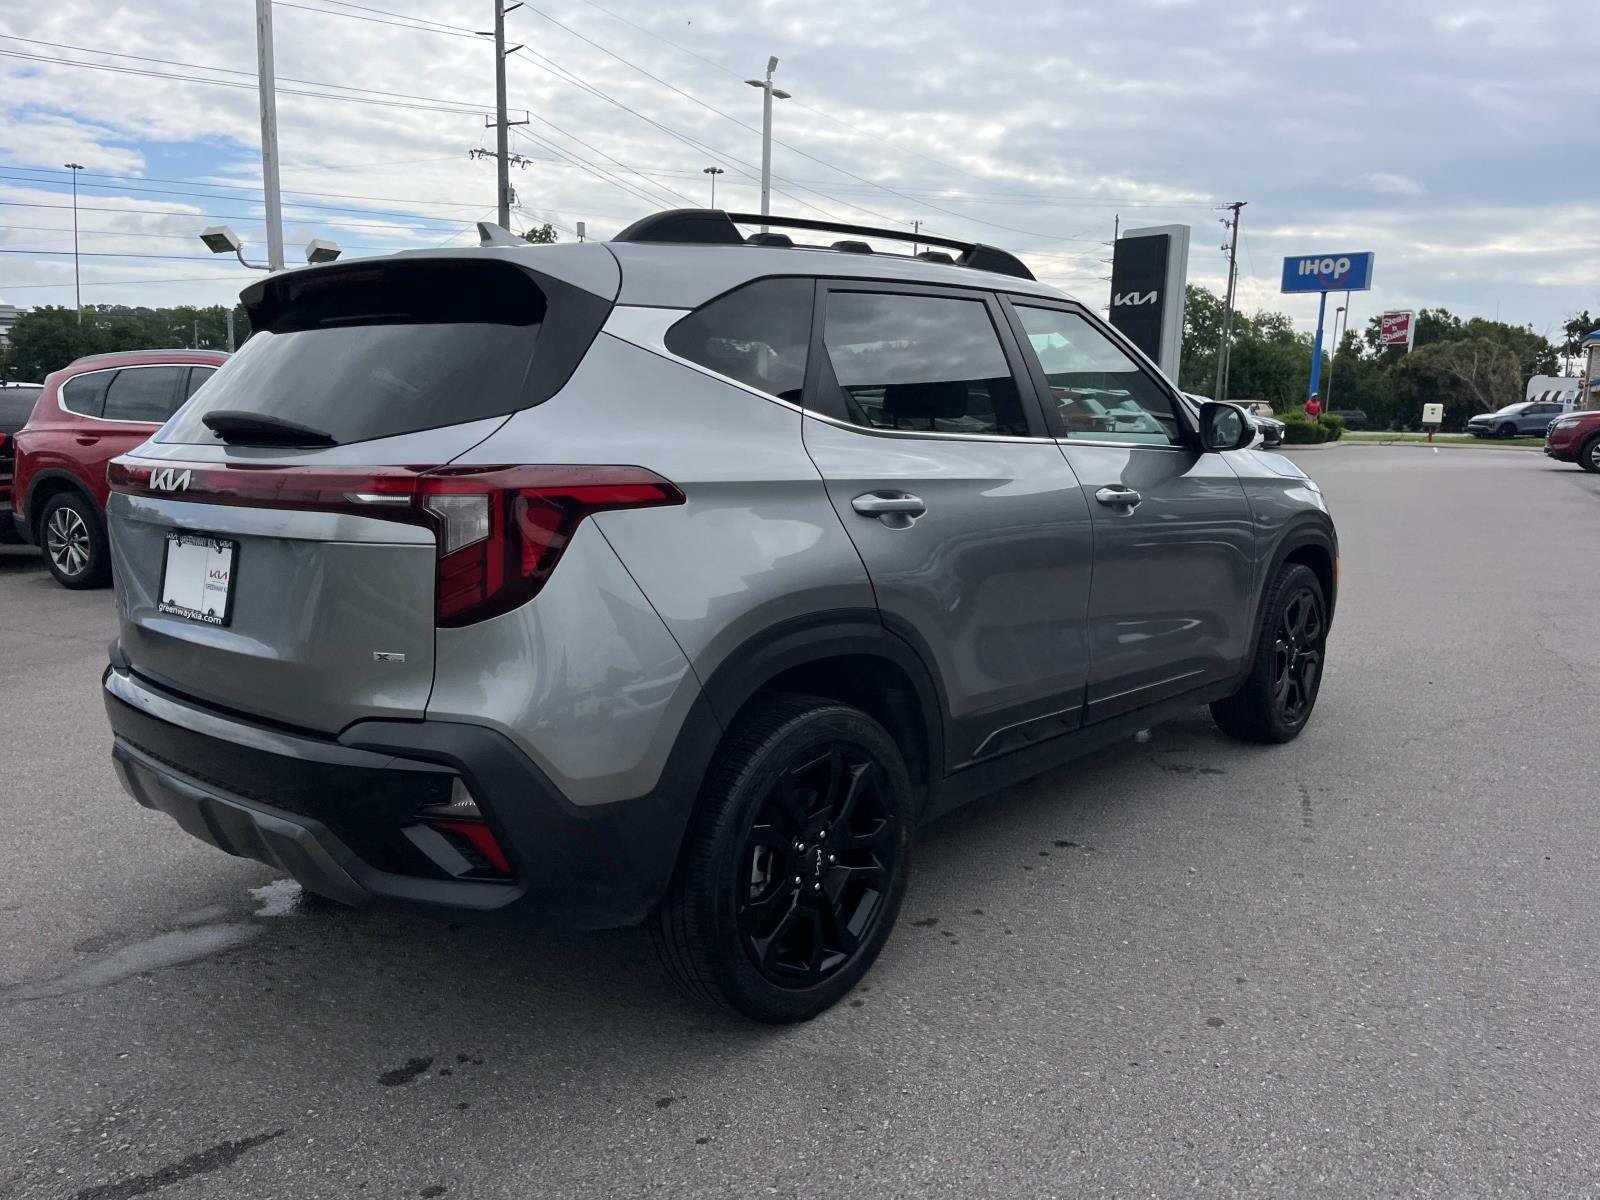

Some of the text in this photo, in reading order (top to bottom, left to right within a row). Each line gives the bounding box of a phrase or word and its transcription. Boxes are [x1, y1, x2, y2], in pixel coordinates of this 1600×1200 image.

[1114, 290, 1158, 306] KIA
[1383, 314, 1408, 328] Steak
[1381, 329, 1408, 344] Shake
[150, 467, 191, 491] KIA
[209, 569, 228, 580] KIA
[158, 603, 222, 625] greenwaykia.com
